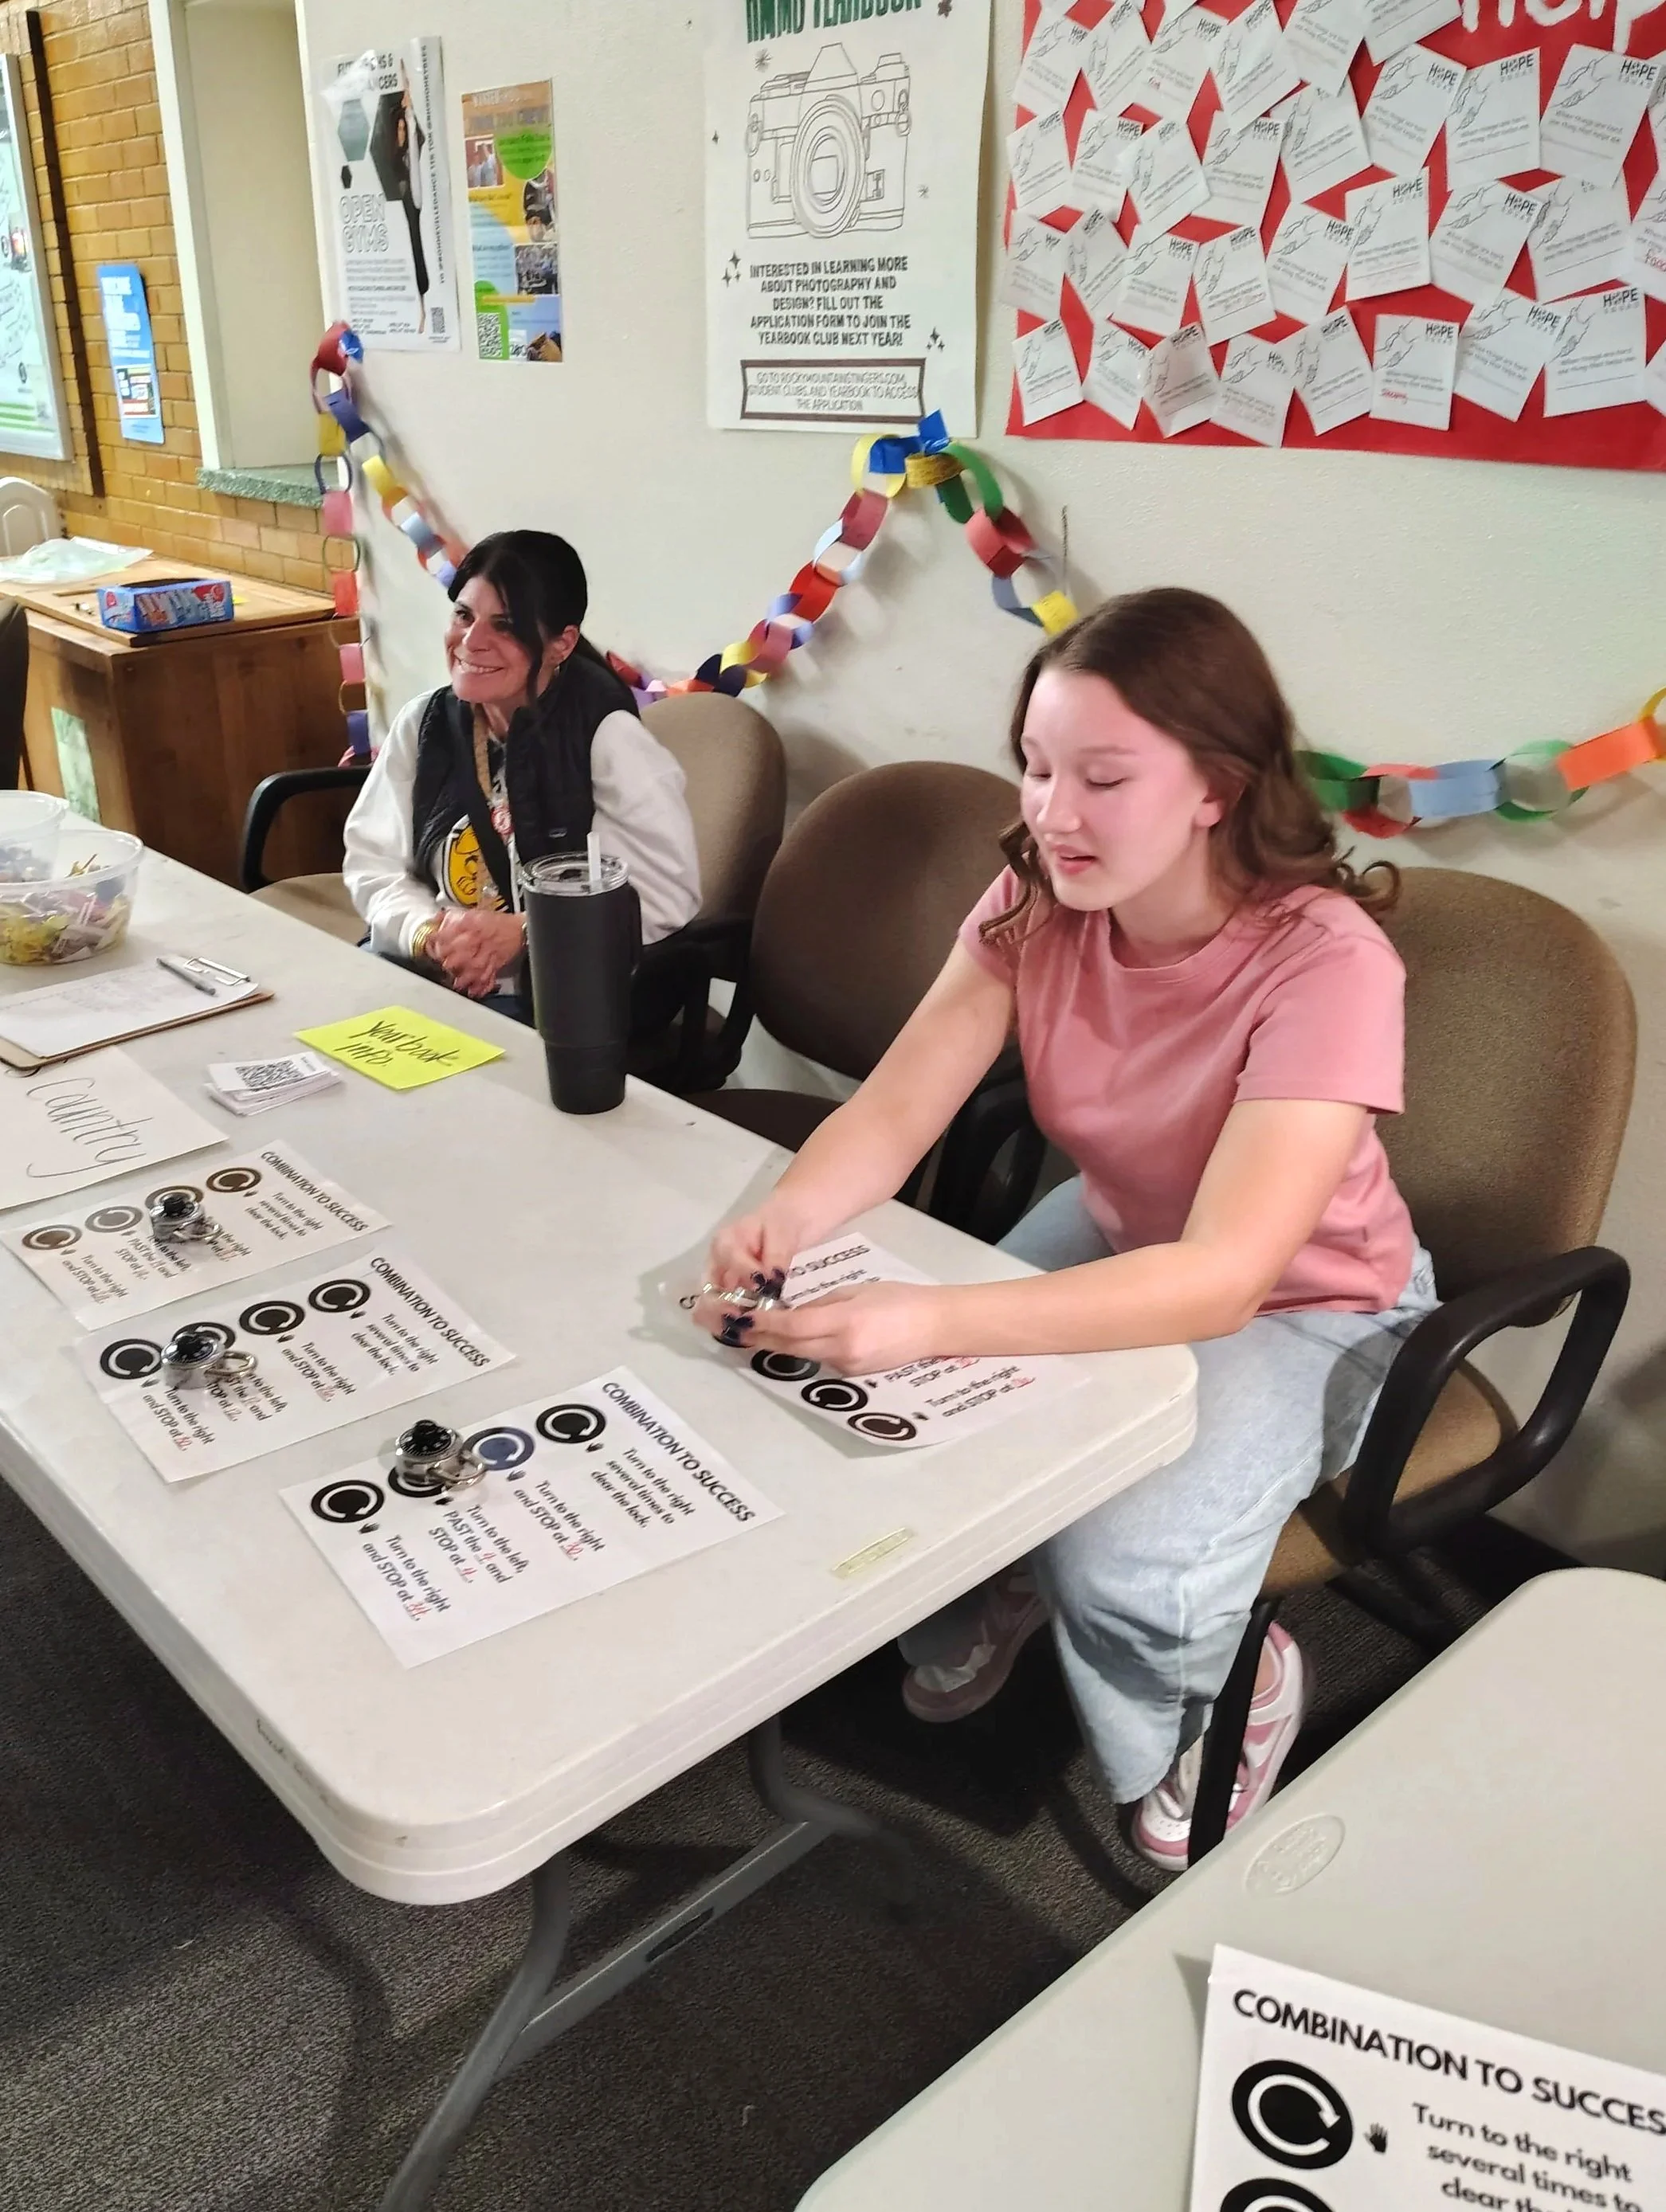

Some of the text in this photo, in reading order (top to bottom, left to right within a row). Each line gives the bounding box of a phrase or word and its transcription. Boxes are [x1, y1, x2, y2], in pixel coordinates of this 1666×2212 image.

[1427, 62, 1458, 85] HOPE
[1500, 53, 1535, 76] HOPE
[1621, 59, 1657, 80] HOPE
[1504, 194, 1537, 216] HOPE
[750, 256, 908, 278] INTERESTED IN LEARNING MORE
[761, 276, 896, 293] ABOUT PHOTOGRAPHY AND
[773, 295, 884, 311] DESIGN? FILL OUT THE
[1528, 305, 1561, 326] HOPE
[1602, 287, 1639, 307] HOPE
[750, 313, 911, 329] APPLICATION FORM TO JOIN THE
[759, 331, 903, 347] YEARBOOK CLUB NEXT YEAR!
[1425, 323, 1454, 339] HOPE
[261, 1152, 319, 1195] COMBINATION
[312, 1192, 331, 1204] TO
[324, 1202, 367, 1231] SUCCESS
[370, 1258, 489, 1366] COMBINATION TO SUCCESS
[382, 1313, 438, 1364] Turn to the right
[281, 1349, 303, 1362] and
[294, 1360, 319, 1379] STOP
[311, 1380, 325, 1388] at
[301, 1341, 355, 1394] Turn to the right
[203, 1381, 227, 1398] TOP
[218, 1400, 233, 1408] at
[233, 1385, 247, 1398] the
[249, 1404, 272, 1420] and
[252, 1378, 287, 1412] to the left,
[143, 1395, 164, 1409] and
[154, 1407, 178, 1427] STOP
[169, 1428, 183, 1438] at
[177, 1404, 188, 1413] to
[183, 1411, 198, 1425] the
[192, 1425, 214, 1443] right
[603, 1383, 754, 1521] COMBINATION TO SUCCESS
[591, 1471, 649, 1527] clear the lock.
[606, 1460, 674, 1523] several times to
[623, 1449, 695, 1514] Turn to the right
[514, 1490, 539, 1507] and
[530, 1506, 560, 1529] STOP
[552, 1532, 569, 1543] at
[535, 1480, 605, 1551] Turn to the right
[429, 1527, 458, 1551] STOP
[449, 1553, 465, 1564] at
[443, 1510, 473, 1535] PAST
[464, 1536, 481, 1552] the
[486, 1563, 512, 1583] and
[466, 1503, 528, 1572] Turn to the left,
[363, 1543, 387, 1562] and
[377, 1562, 406, 1587] STOP
[397, 1590, 414, 1602] at
[386, 1534, 450, 1611] Turn to the right
[1233, 1989, 1468, 2082] COMBINATION
[1476, 2059, 1522, 2094] TO
[1413, 2103, 1633, 2183] Turn to the right
[1427, 2143, 1643, 2212] several times to
[1441, 2176, 1510, 2211] clear
